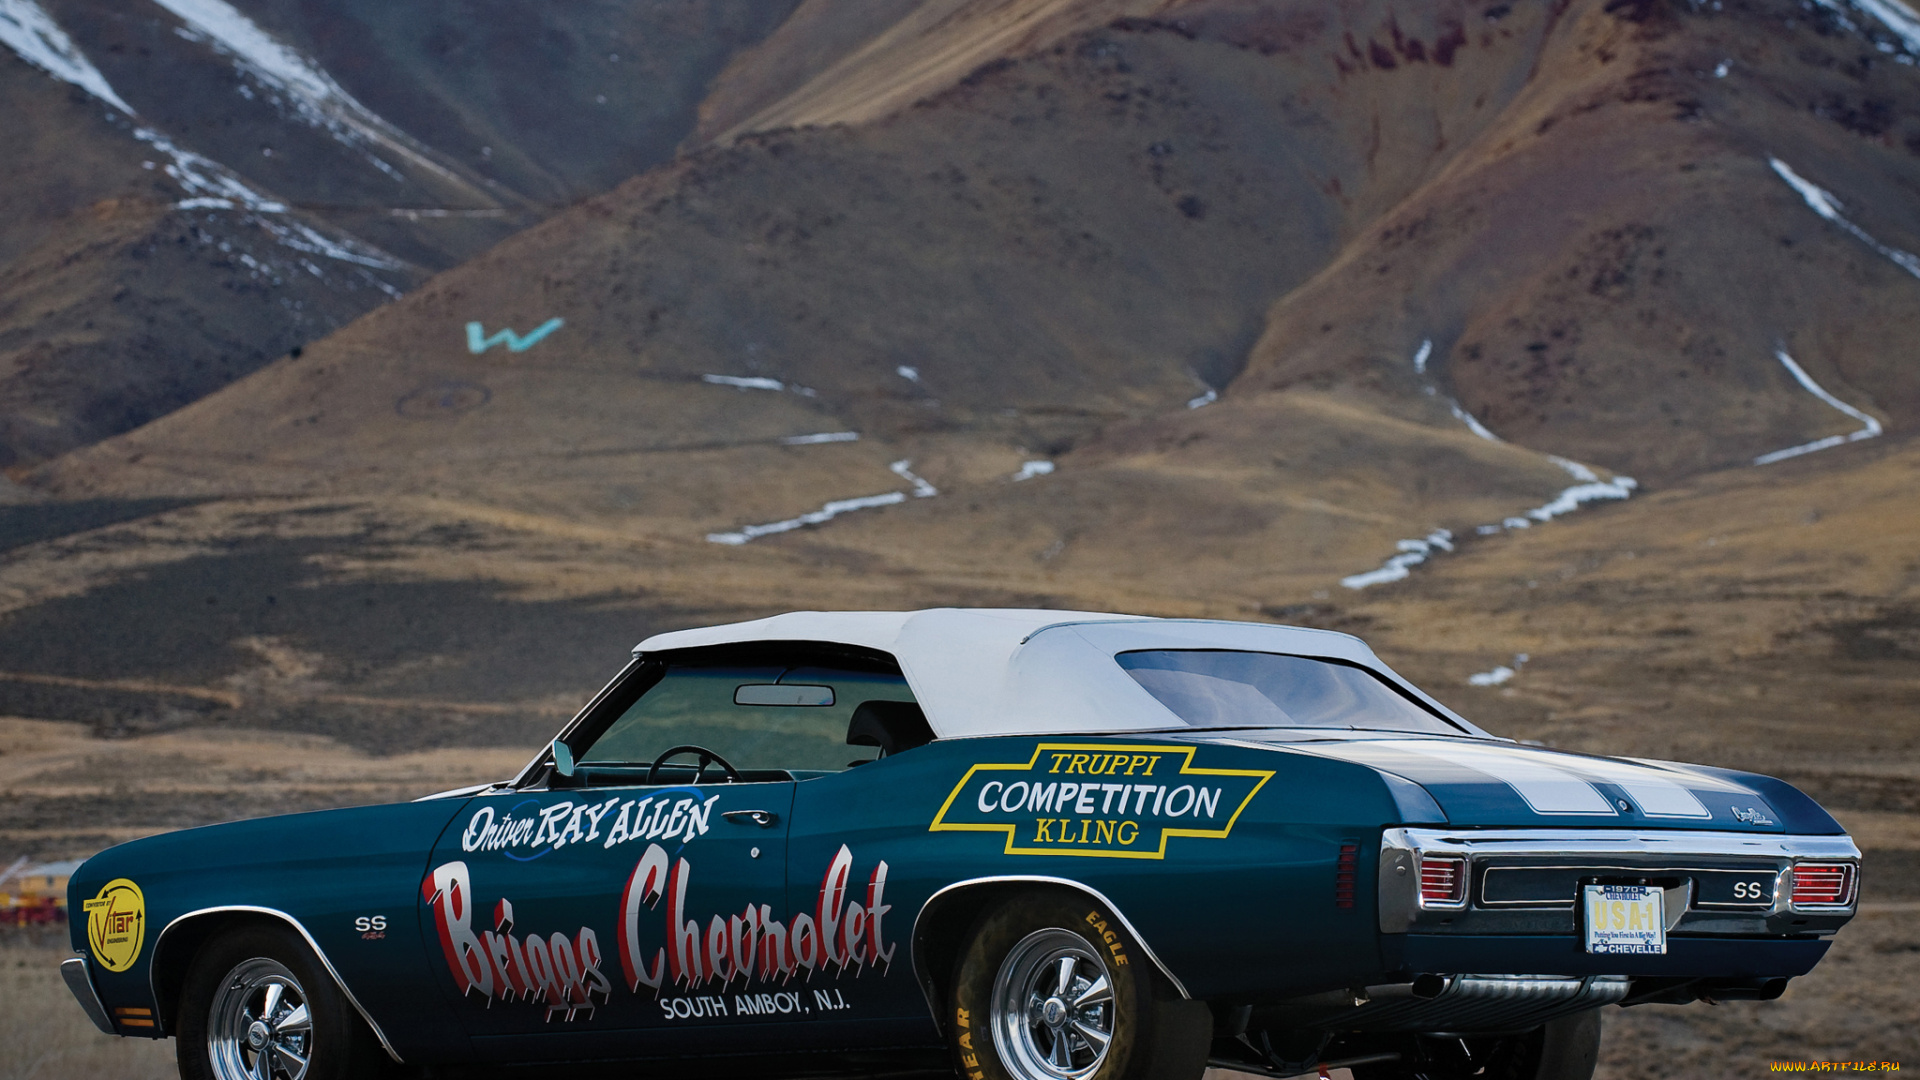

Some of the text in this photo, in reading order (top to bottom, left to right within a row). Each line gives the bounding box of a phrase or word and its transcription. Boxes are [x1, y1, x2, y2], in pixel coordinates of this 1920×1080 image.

[1049, 753, 1162, 777] TRUPPI
[977, 781, 1223, 819] COMPETITION
[462, 794, 720, 852] Driver RAY ALLEN
[1033, 818, 1140, 845] KLING
[1733, 881, 1762, 899] SS
[355, 915, 387, 931] SS
[424, 843, 897, 1021] Briggs Chevrolet
[1085, 910, 1129, 967] EAGLE
[1608, 944, 1661, 954] CHEVELLE
[660, 988, 850, 1020] SOUTH AMBOY, N.J.
